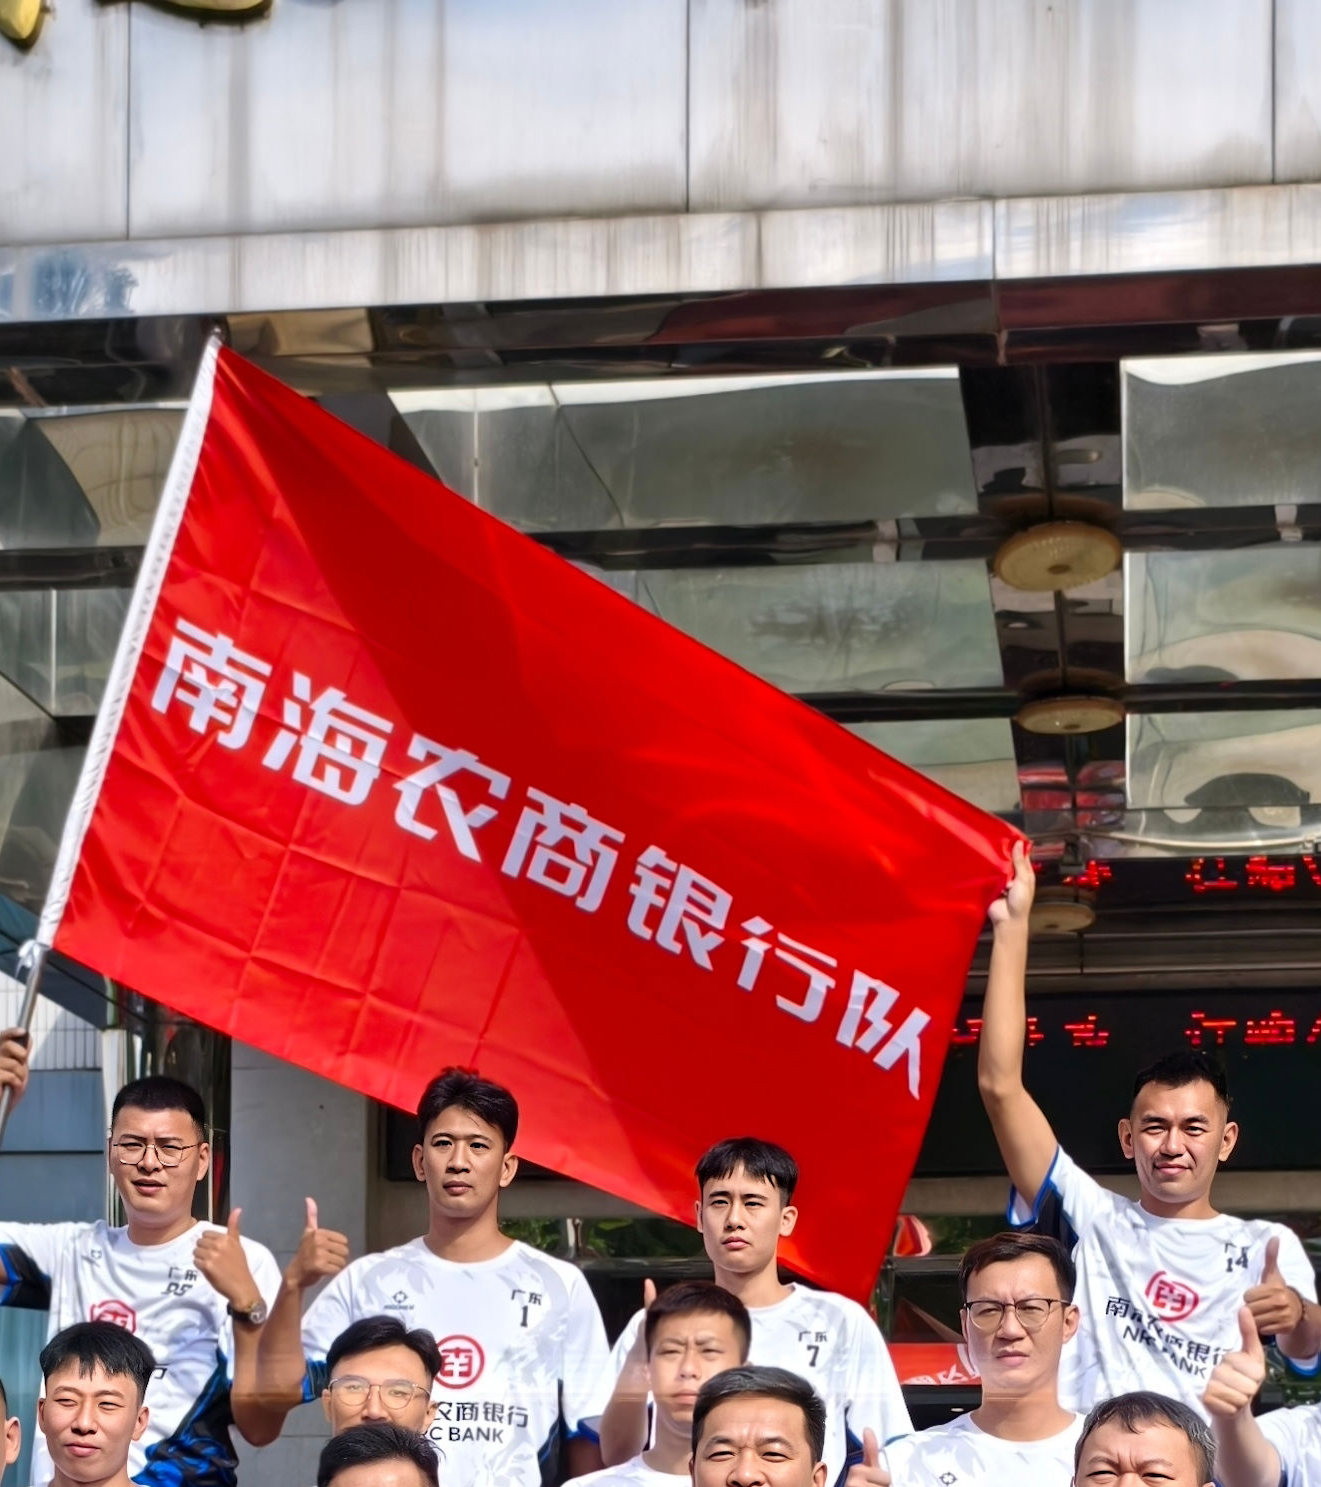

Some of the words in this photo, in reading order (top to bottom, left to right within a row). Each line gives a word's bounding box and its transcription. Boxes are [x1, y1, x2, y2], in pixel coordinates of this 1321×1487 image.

[150, 617, 932, 1100] 南海农商银行队
[511, 1289, 542, 1306] 广东
[519, 1305, 529, 1328] 1
[798, 1330, 828, 1343] 广东
[806, 1345, 820, 1367] 7
[448, 1427, 504, 1444] BANK
